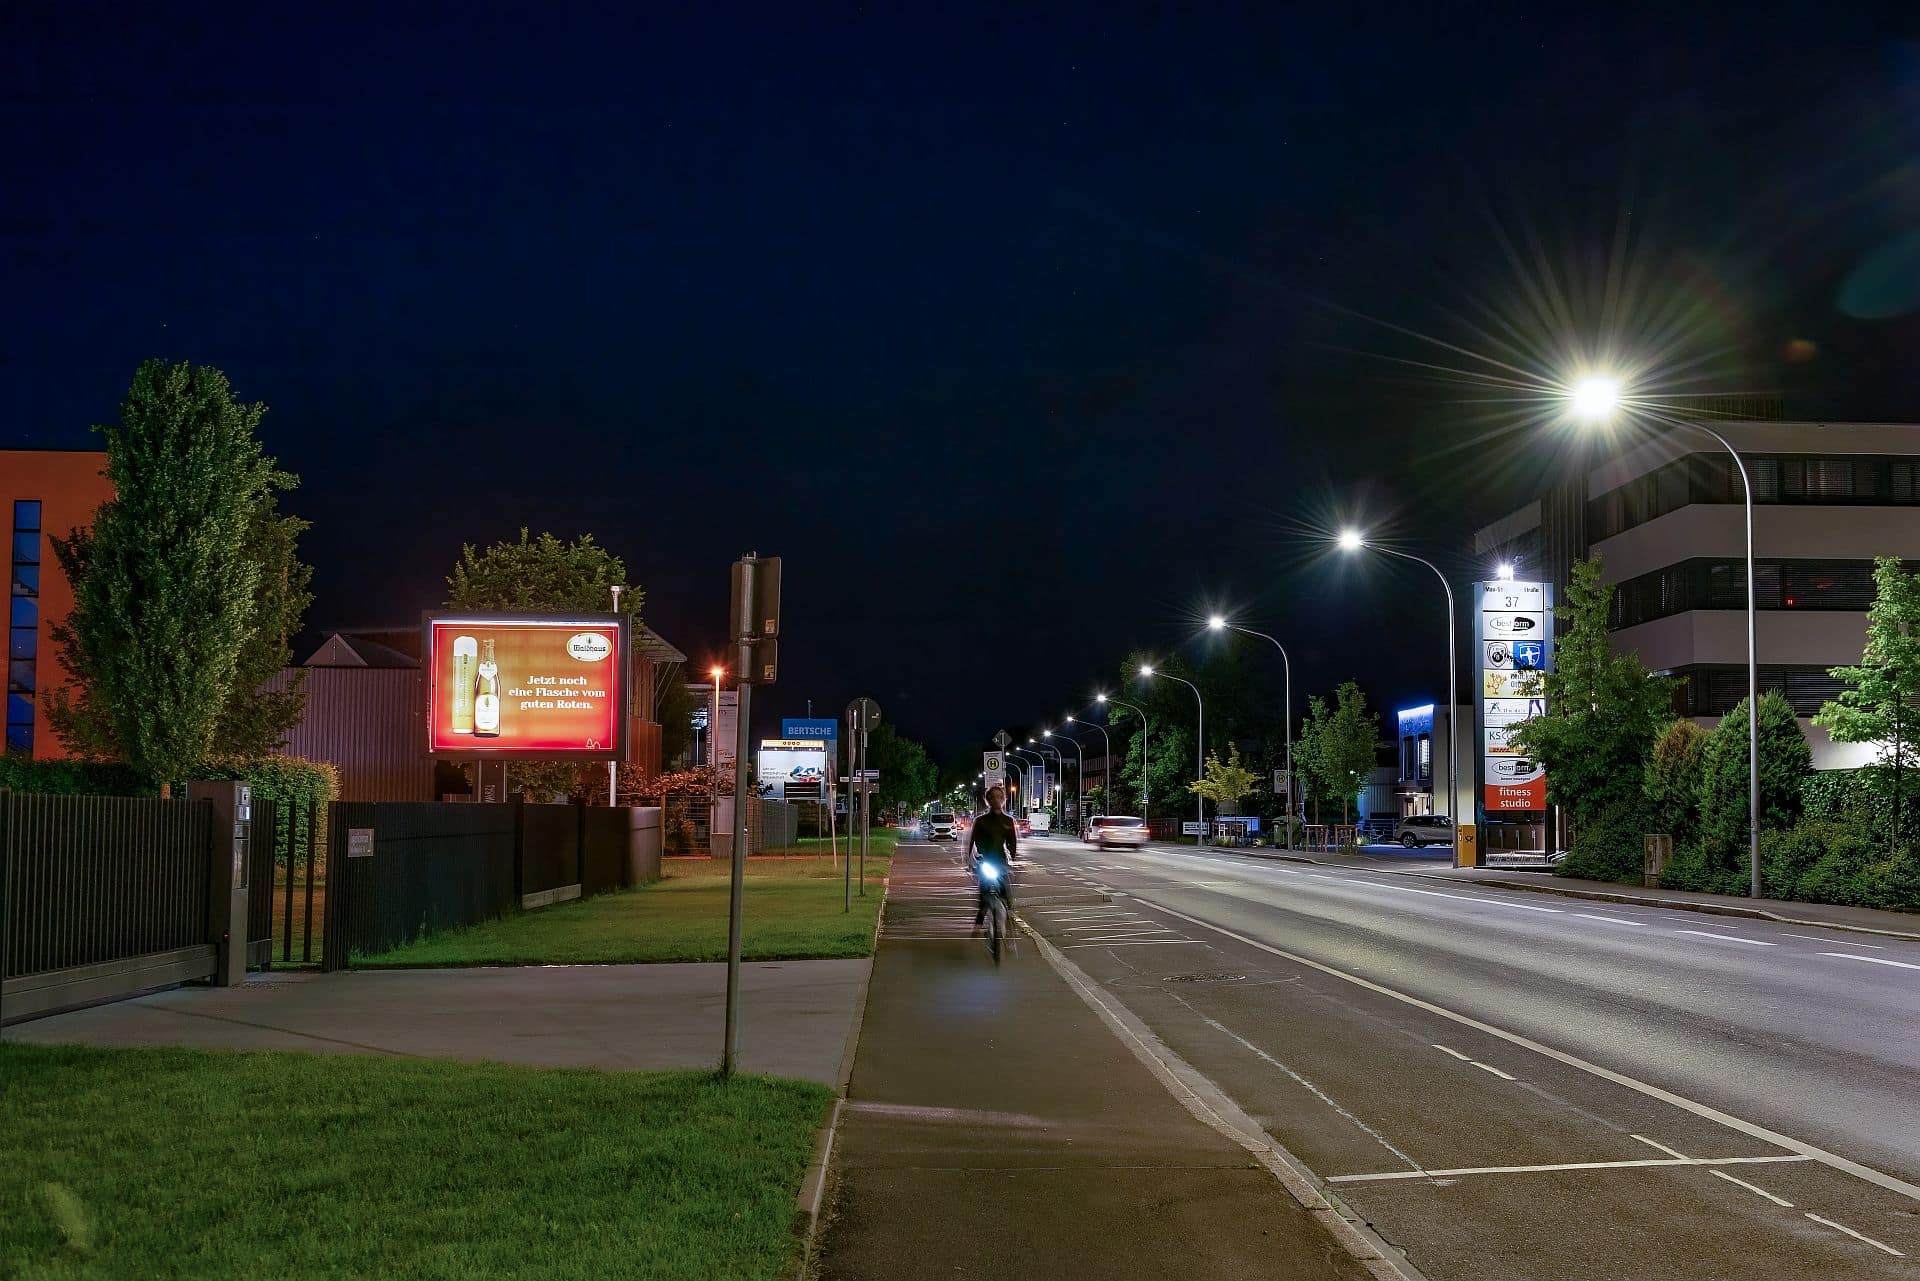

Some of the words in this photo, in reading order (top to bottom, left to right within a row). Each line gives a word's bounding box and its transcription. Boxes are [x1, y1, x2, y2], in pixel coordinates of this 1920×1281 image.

[1506, 596, 1519, 608] 37
[527, 676, 556, 685] Jetzt
[559, 676, 587, 685] noch
[508, 688, 533, 696] eine
[536, 688, 579, 697] Flasche
[520, 700, 554, 710] guten
[557, 700, 593, 709] Roten.
[788, 727, 832, 735] BERTSCHE
[1499, 787, 1532, 796] fitness
[1500, 799, 1530, 808] studio
